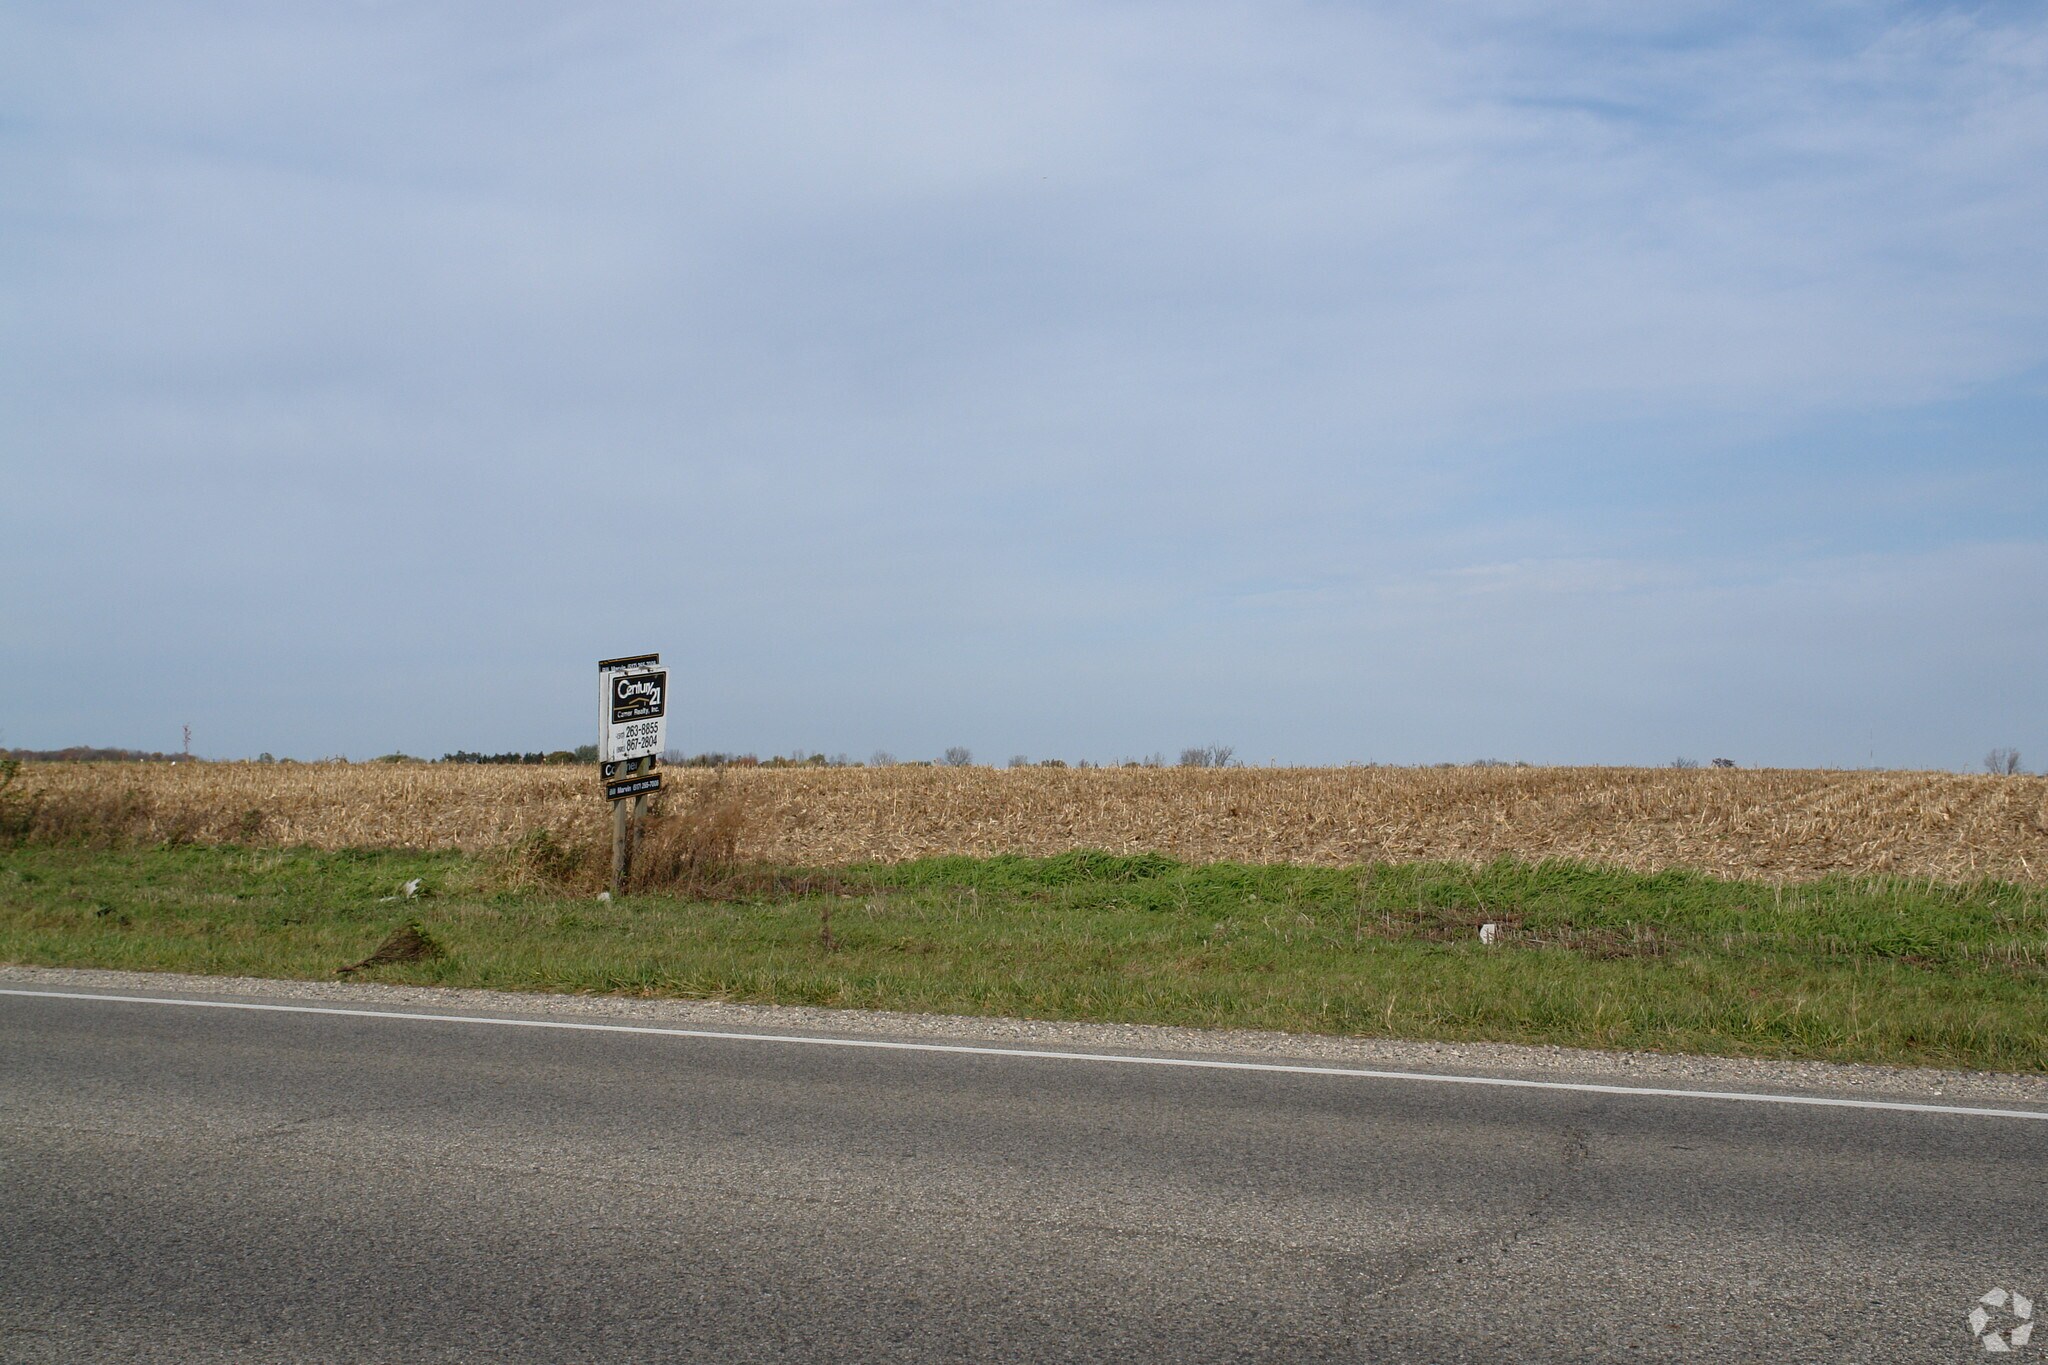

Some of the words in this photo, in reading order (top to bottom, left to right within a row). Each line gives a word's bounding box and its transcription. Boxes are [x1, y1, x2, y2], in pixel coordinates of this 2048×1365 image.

[617, 680, 654, 699] Century
[649, 687, 661, 705] 21
[626, 722, 659, 738] 263-8855
[626, 735, 657, 751] 867-2804
